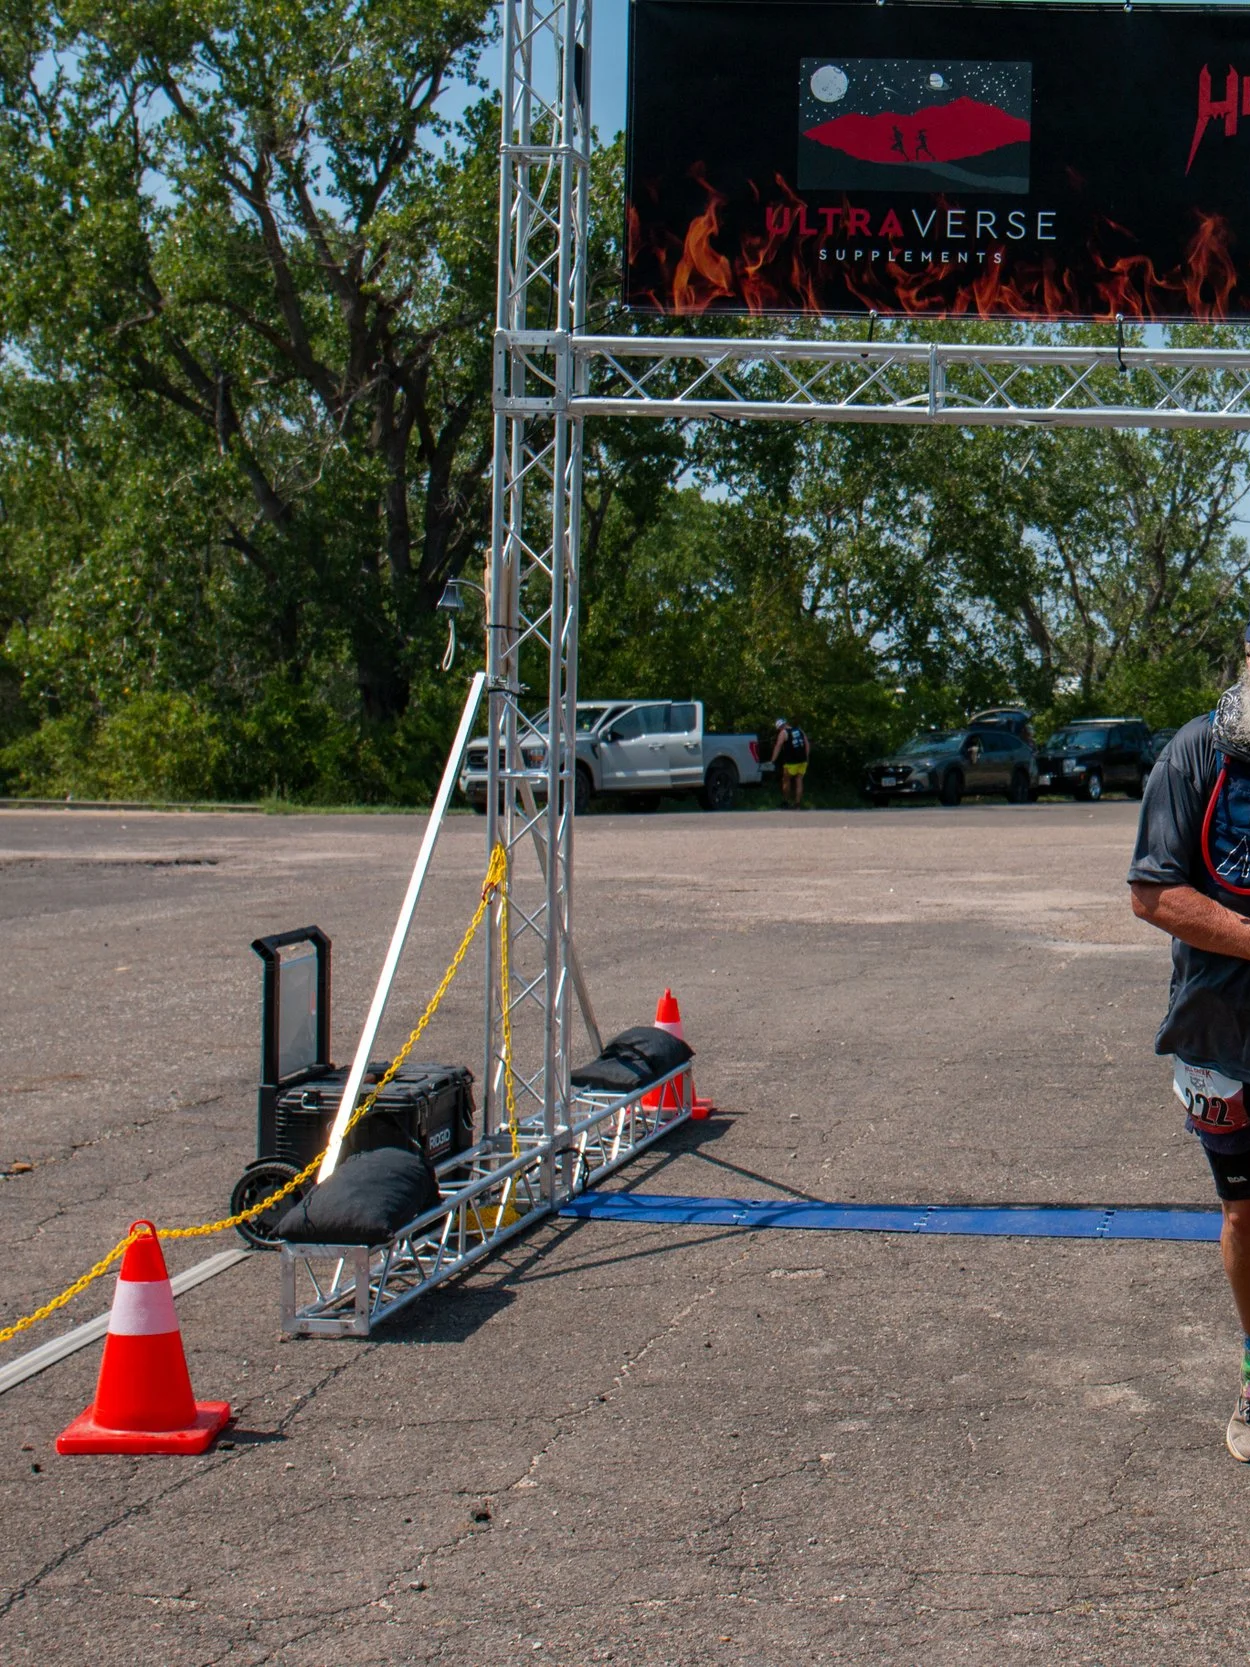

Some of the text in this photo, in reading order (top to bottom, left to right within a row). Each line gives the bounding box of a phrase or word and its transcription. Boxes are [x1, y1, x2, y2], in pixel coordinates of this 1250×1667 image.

[765, 207, 1057, 241] ULTRAVERSE
[819, 249, 1003, 264] SUPPLEMENTS
[1185, 1087, 1234, 1126] 222
[429, 1128, 451, 1150] RIDGID
